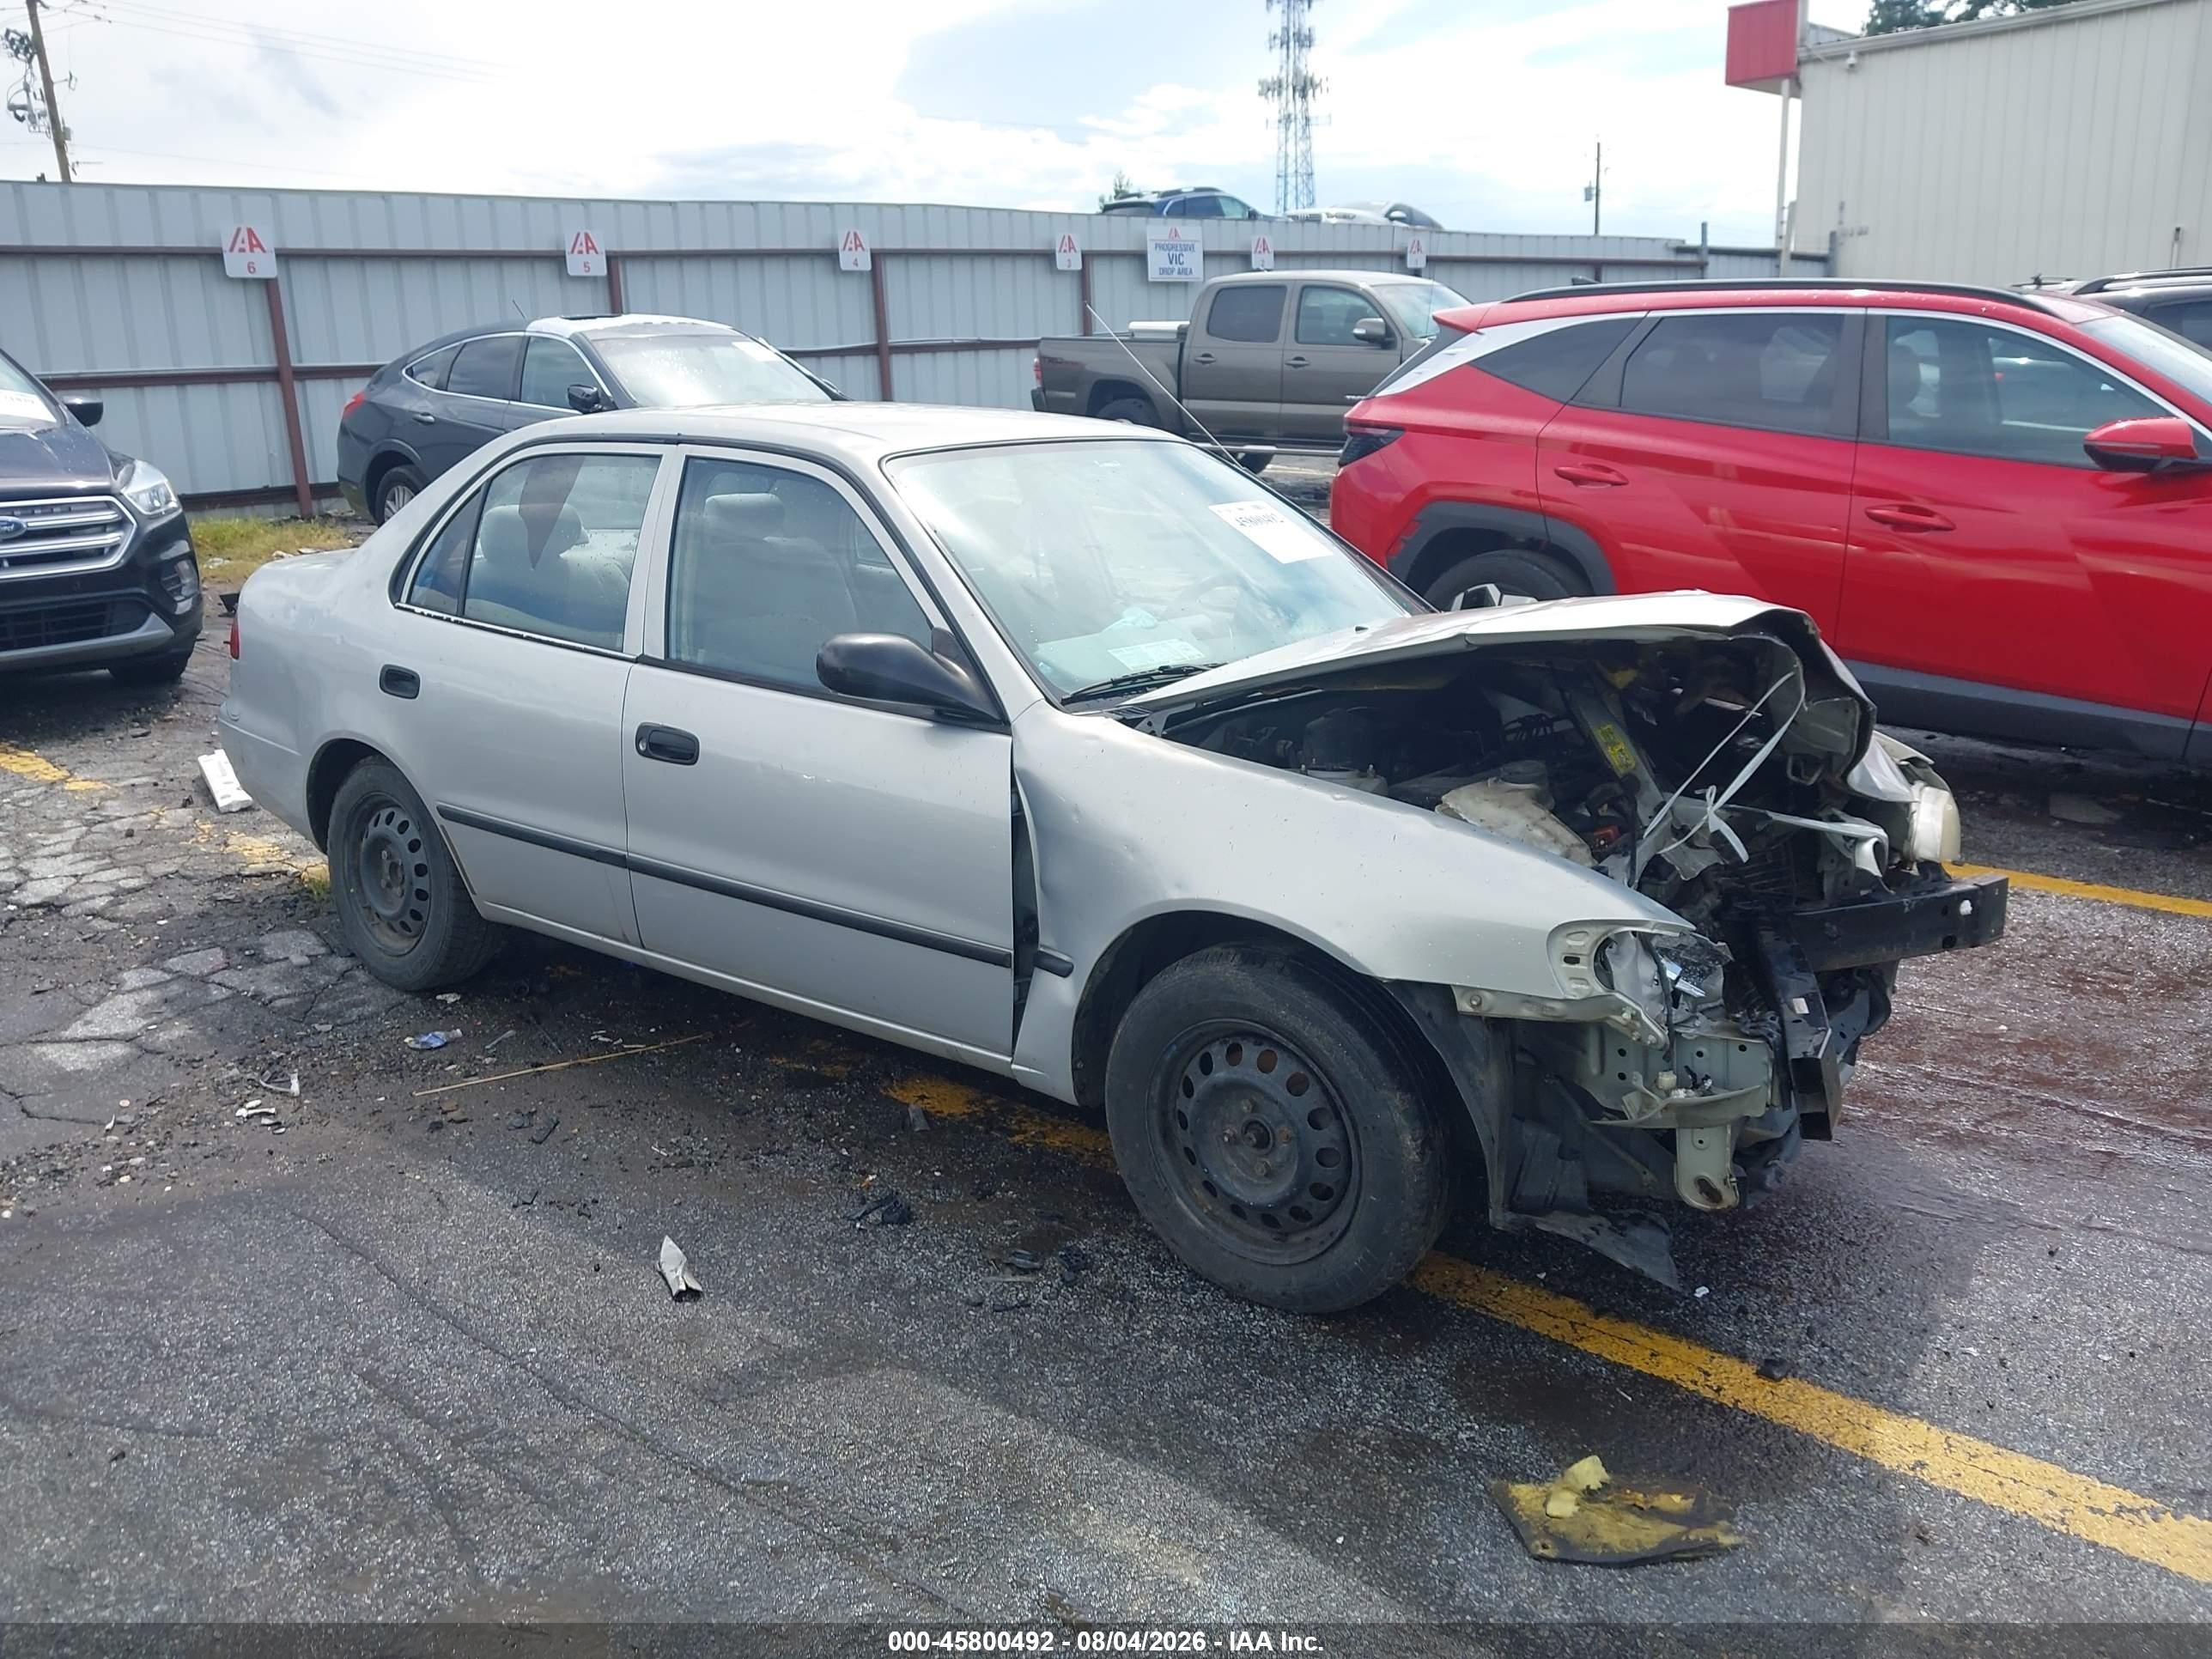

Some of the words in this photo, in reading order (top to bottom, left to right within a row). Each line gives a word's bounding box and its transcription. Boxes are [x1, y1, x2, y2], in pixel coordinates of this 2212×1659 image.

[1154, 242, 1196, 252] PROGRESSIVE
[852, 257, 859, 267] 4
[1168, 252, 1185, 265] VIC
[247, 261, 256, 275] 6
[584, 260, 591, 273] 5
[1159, 267, 1176, 276] DROP
[1177, 267, 1194, 276] AREA
